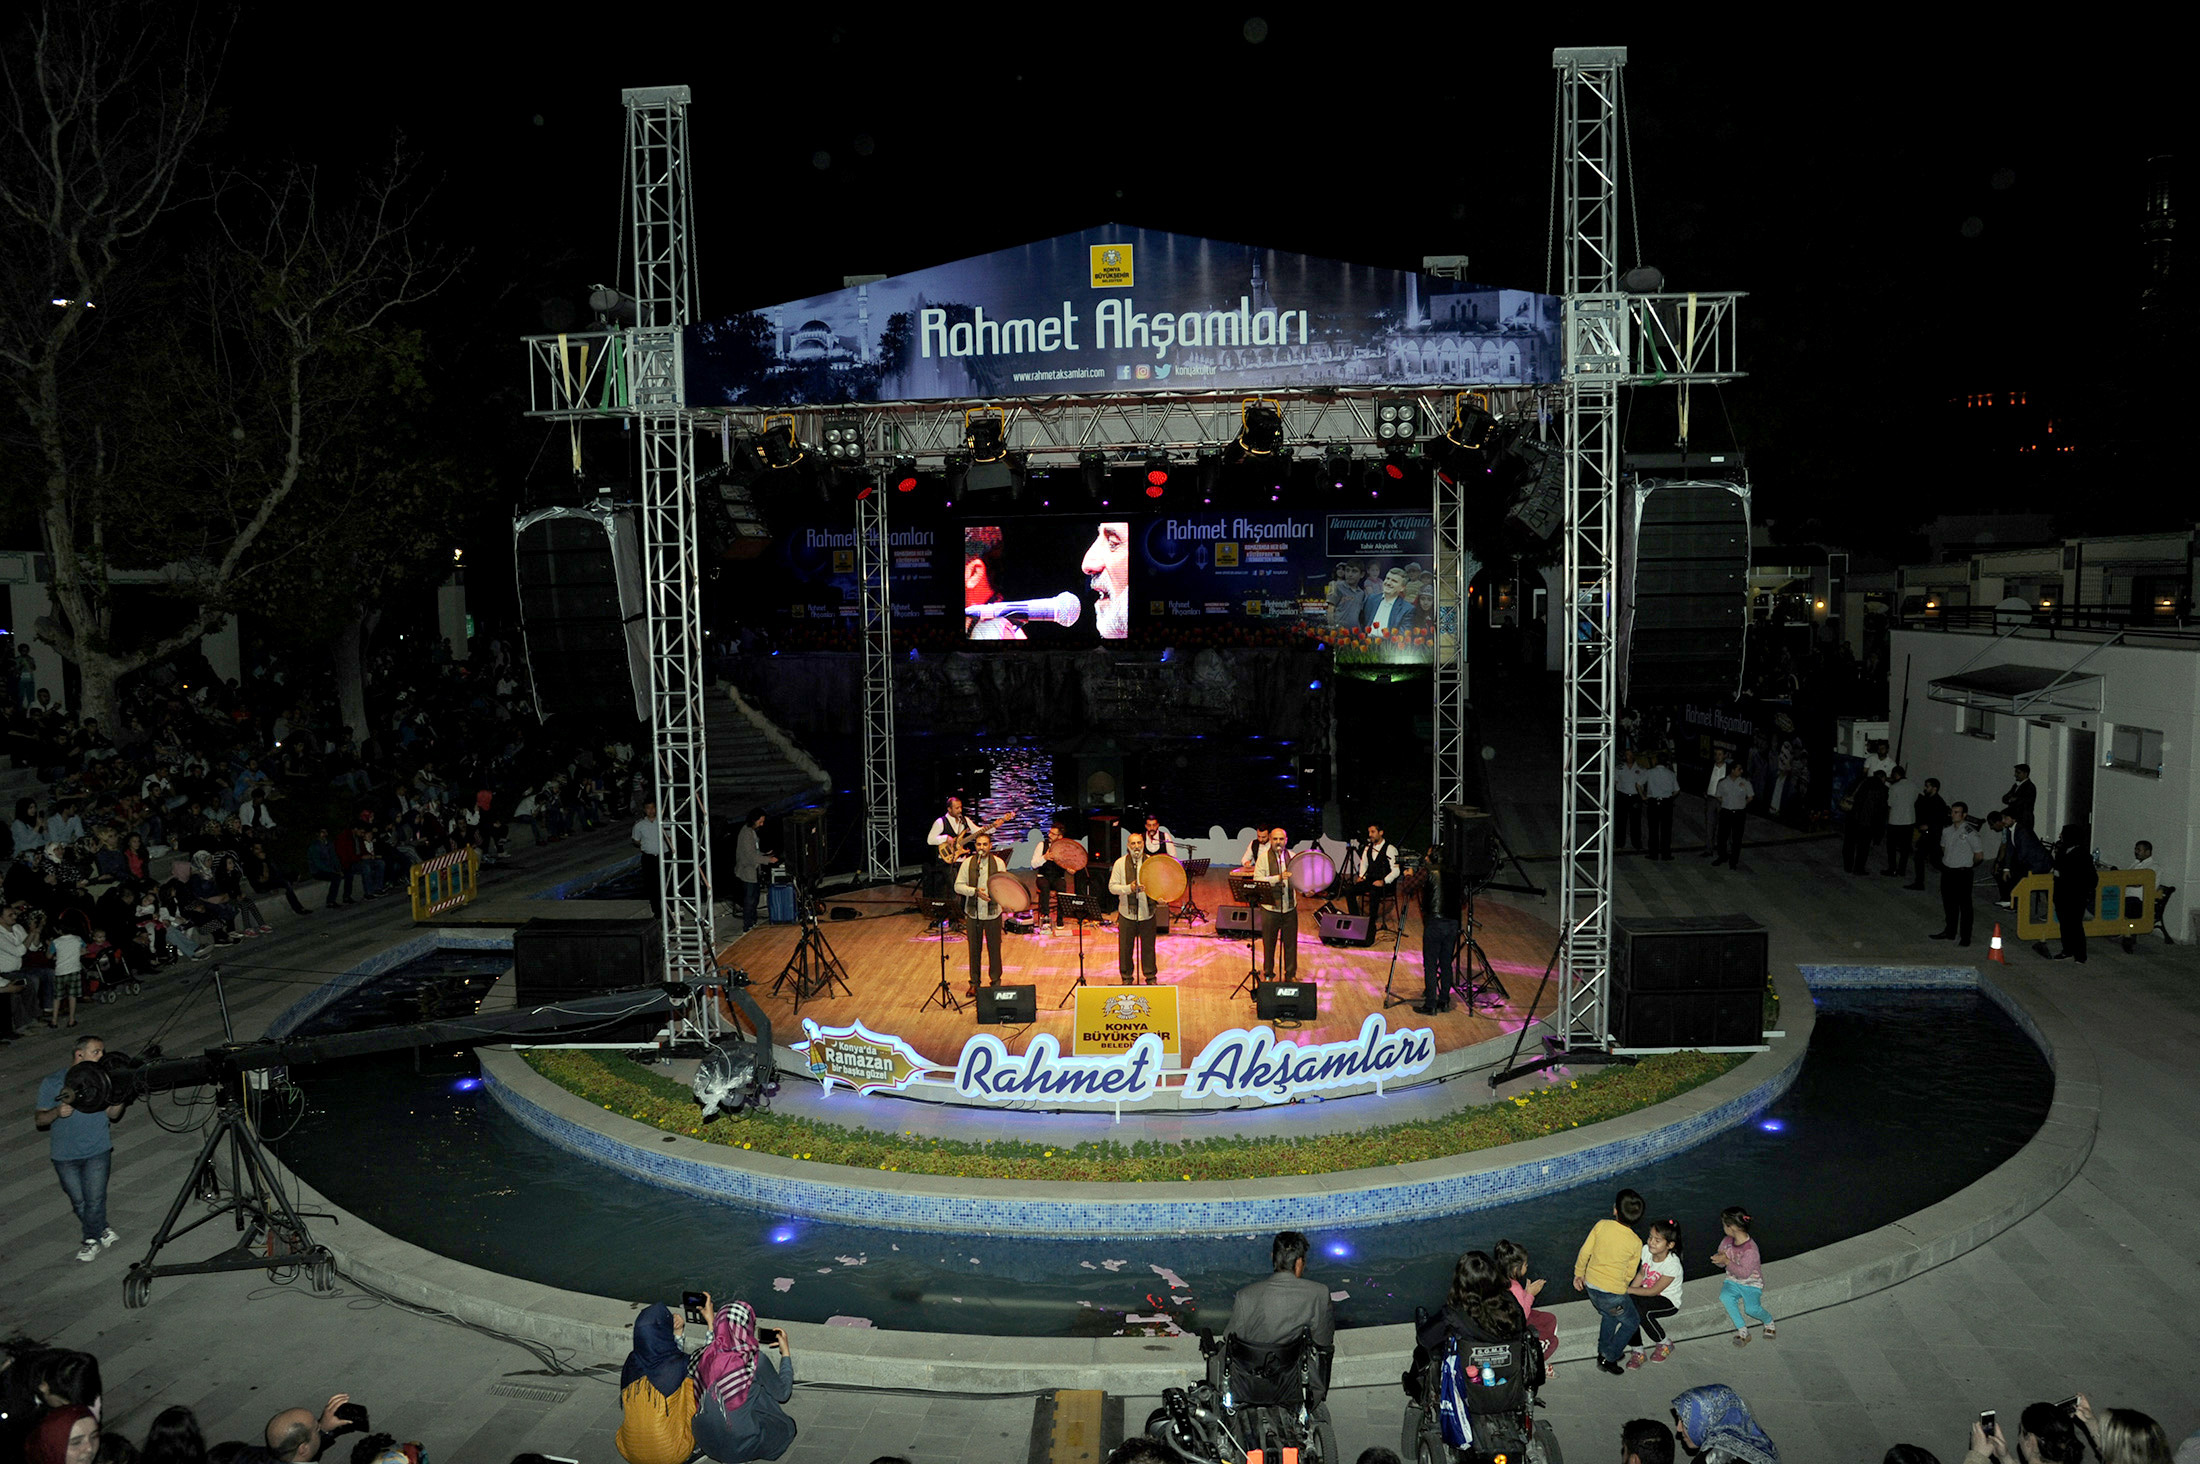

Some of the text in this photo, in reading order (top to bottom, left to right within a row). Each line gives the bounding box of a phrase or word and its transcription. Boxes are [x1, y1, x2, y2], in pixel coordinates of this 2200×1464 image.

[920, 295, 1308, 360] Rahmet Akşamları
[1012, 367, 1105, 382] www.rahmetaksamlari.com
[1166, 517, 1314, 543] Rahmet Akşamları
[1685, 704, 1713, 727] Rahmet
[995, 991, 1017, 1000] NET
[1105, 1023, 1149, 1031] KONYA
[838, 1040, 878, 1055] Konya'da
[824, 1047, 894, 1071] Ramazan
[962, 1024, 1431, 1094] Rahmet Akşamları
[831, 1063, 887, 1080] bir başka güzel
